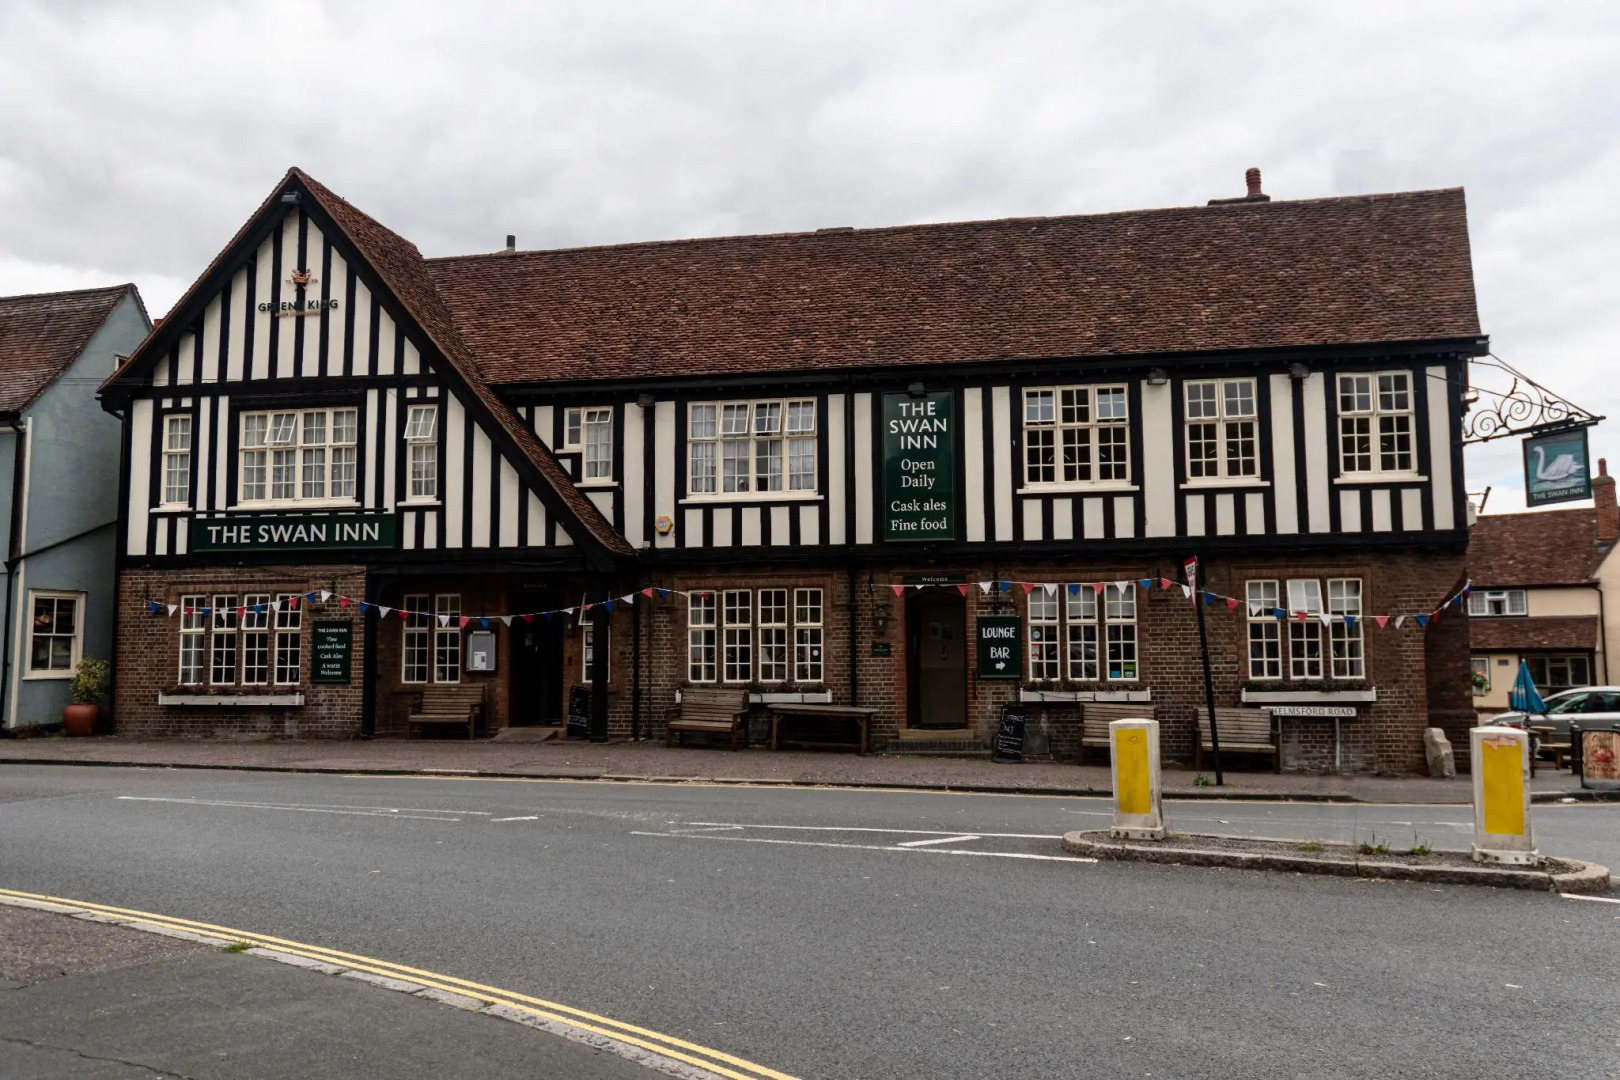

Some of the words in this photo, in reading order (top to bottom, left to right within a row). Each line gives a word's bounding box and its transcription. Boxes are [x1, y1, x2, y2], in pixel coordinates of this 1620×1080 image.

[308, 299, 338, 310] KING
[899, 401, 936, 417] THE
[889, 418, 947, 434] SWAN
[900, 435, 937, 450] INN
[901, 458, 935, 473] Open
[901, 474, 935, 490] Daily
[1532, 492, 1546, 500] THE
[1547, 489, 1568, 498] SWAN
[1569, 487, 1584, 495] INN
[890, 499, 921, 512] Cask
[923, 498, 947, 511] ales
[890, 519, 918, 531] Fine
[920, 517, 947, 530] food
[207, 525, 251, 544] THE
[258, 523, 327, 543] SWAN
[334, 522, 380, 541] INN
[982, 627, 1016, 639] LOUNGE
[990, 646, 1010, 659] BAR
[1328, 707, 1353, 716] ROAD
